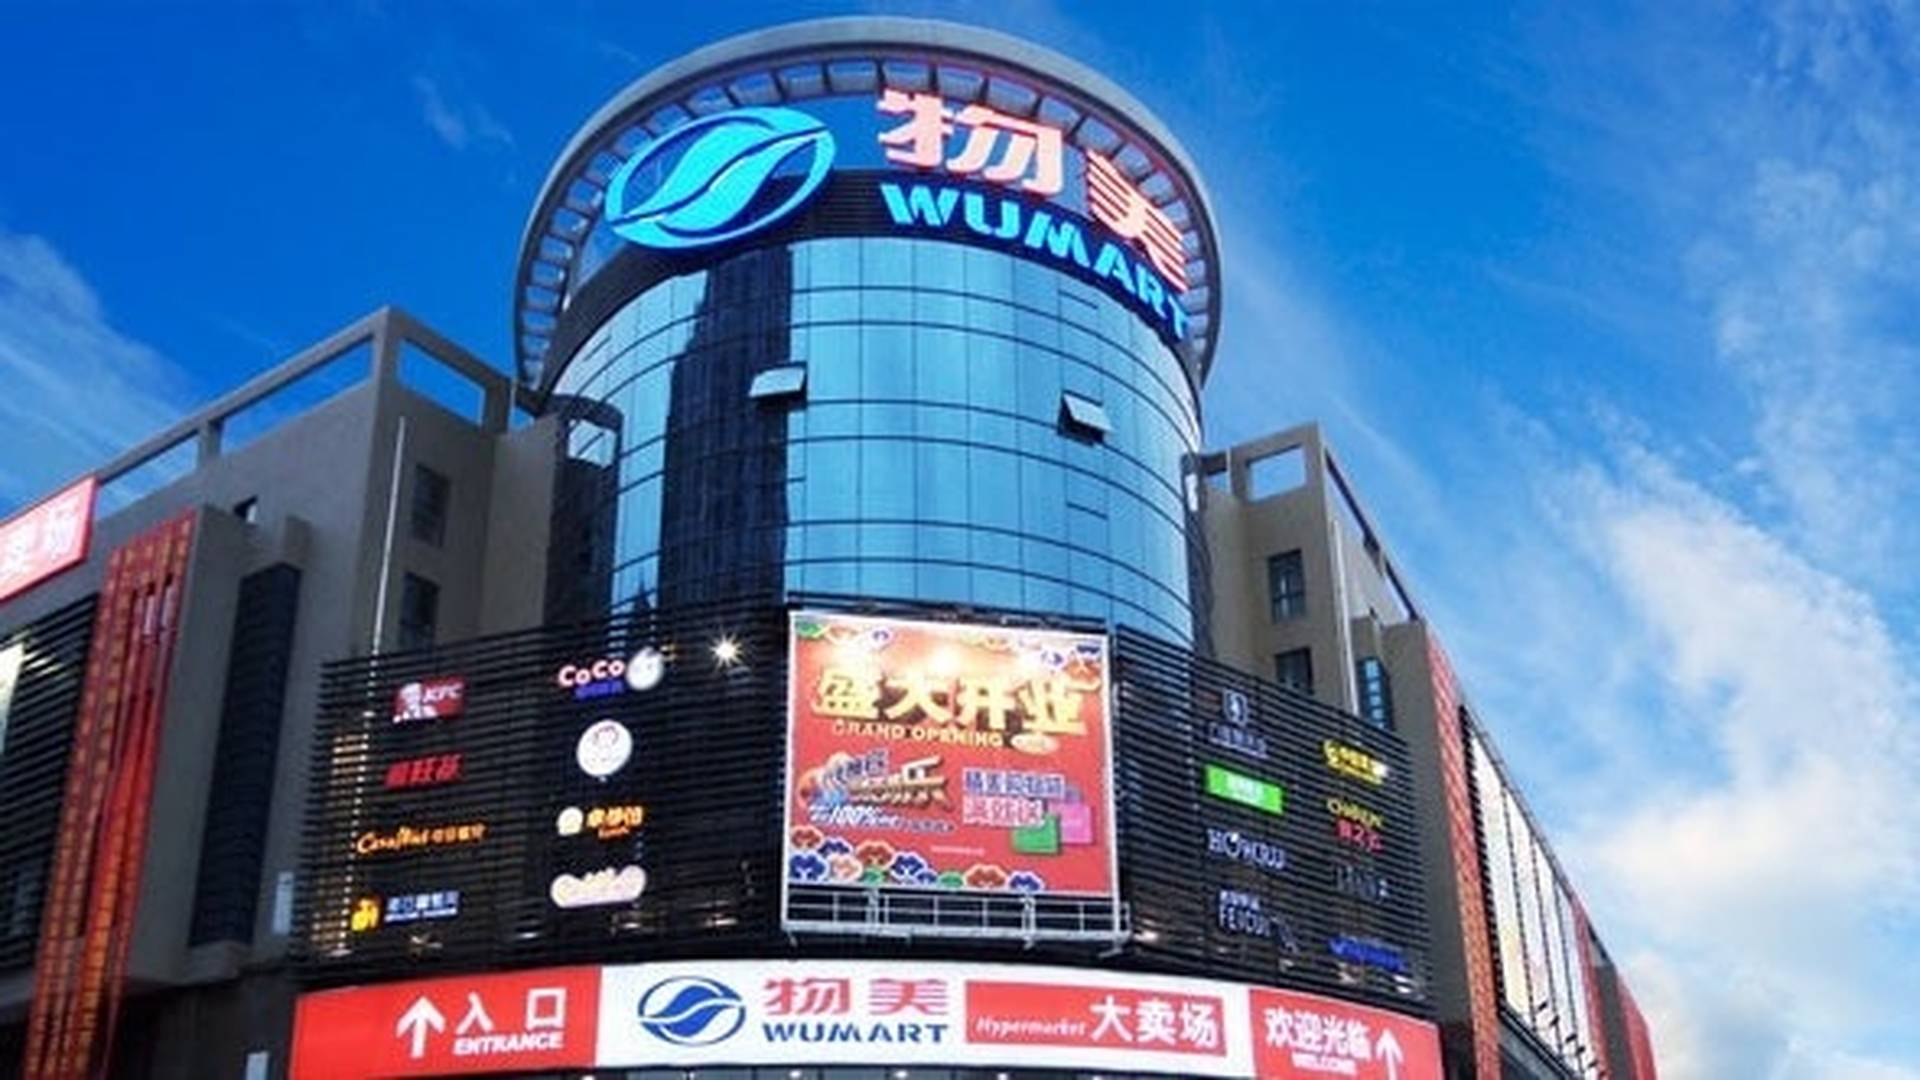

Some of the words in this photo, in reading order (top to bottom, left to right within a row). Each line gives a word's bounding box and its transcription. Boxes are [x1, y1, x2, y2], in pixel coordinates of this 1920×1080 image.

[877, 87, 1189, 294] 物美
[880, 183, 1189, 340] WUMART
[422, 682, 463, 703] KFC
[810, 668, 1088, 736] 盛大开业
[831, 718, 907, 741] GRAND
[910, 726, 1004, 750] OPENING
[455, 986, 567, 1036] 入口
[763, 977, 950, 1016] 物美
[453, 1030, 566, 1056] ENTRANCE
[762, 1022, 950, 1044] WUMART
[975, 1015, 1088, 1038] Hypermarket
[1089, 994, 1219, 1050] 大卖场
[1263, 1006, 1373, 1062] 欢迎光临
